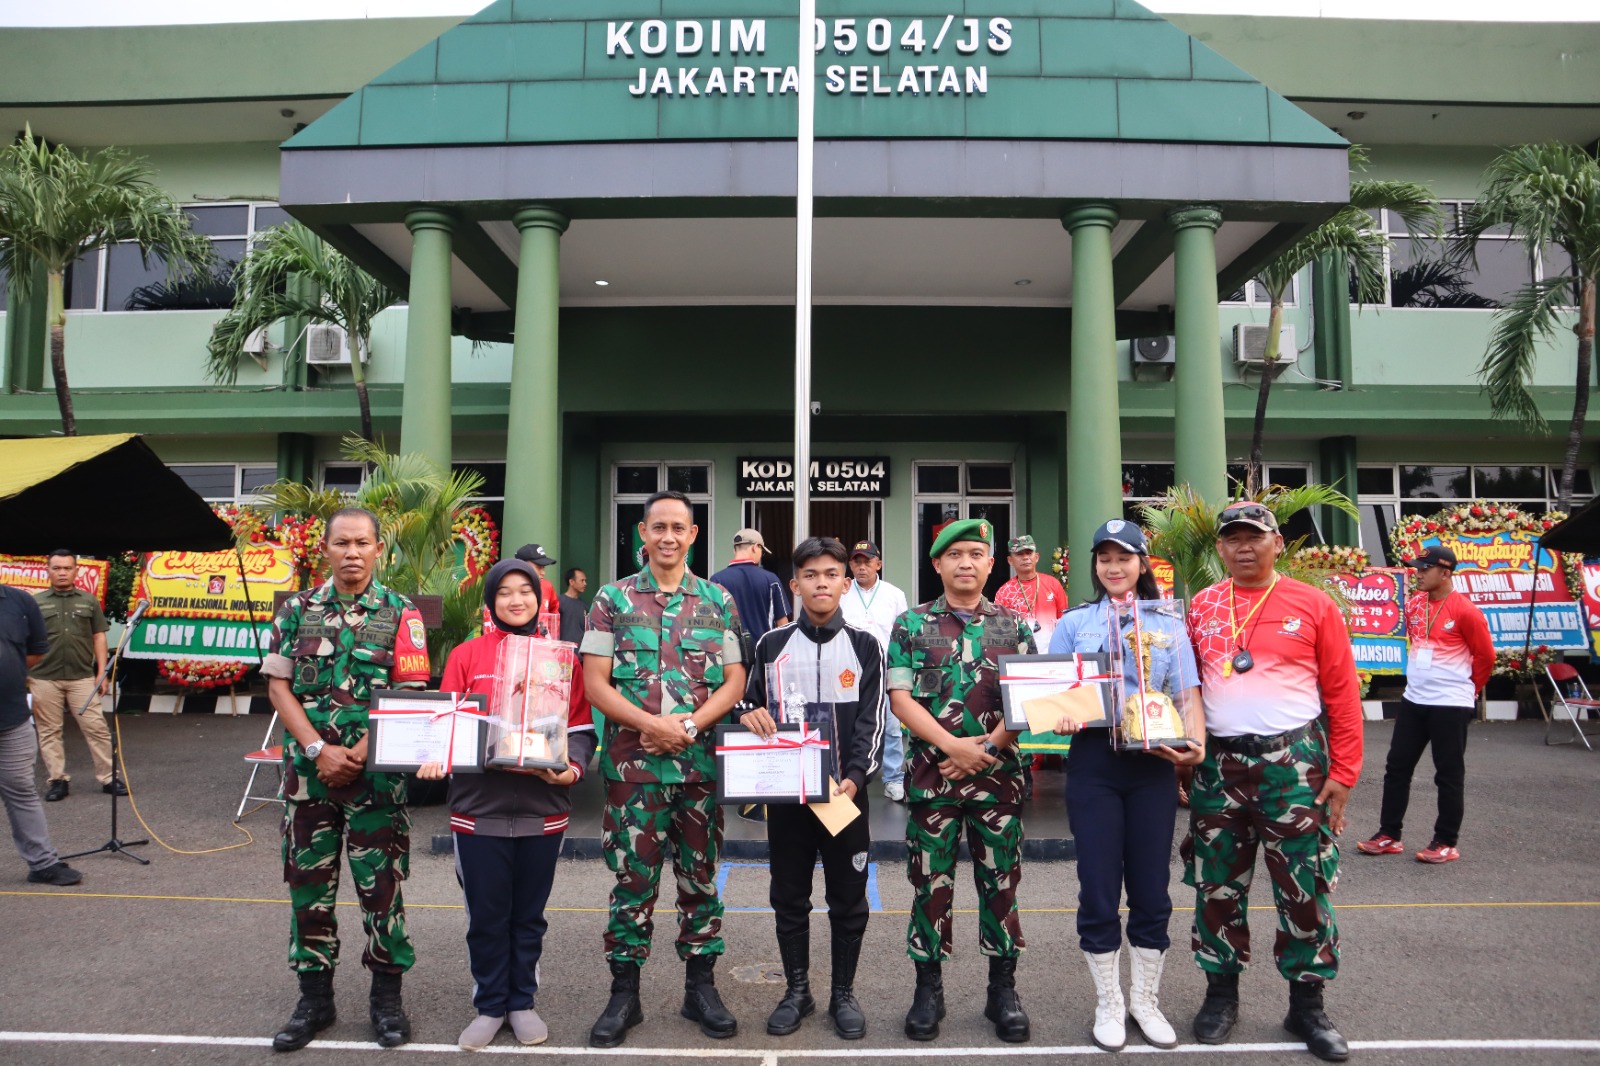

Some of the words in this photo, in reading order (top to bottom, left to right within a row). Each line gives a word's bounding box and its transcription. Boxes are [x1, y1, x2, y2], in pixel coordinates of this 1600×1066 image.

[606, 19, 766, 56] KODIM
[629, 67, 799, 95] JAKARTA
[825, 65, 988, 94] SELATAN
[742, 461, 819, 478] KODM
[826, 461, 885, 478] 0504
[747, 481, 813, 492] JAKAR
[817, 481, 880, 492] SELATAN
[1338, 580, 1389, 600] Sukses
[1469, 574, 1512, 592] NASIONAL
[153, 596, 188, 609] TENTARA
[189, 598, 228, 611] NASIONAL
[230, 600, 273, 612] INDONESIA
[144, 623, 196, 646] ROMY
[1351, 645, 1401, 662] MANSION
